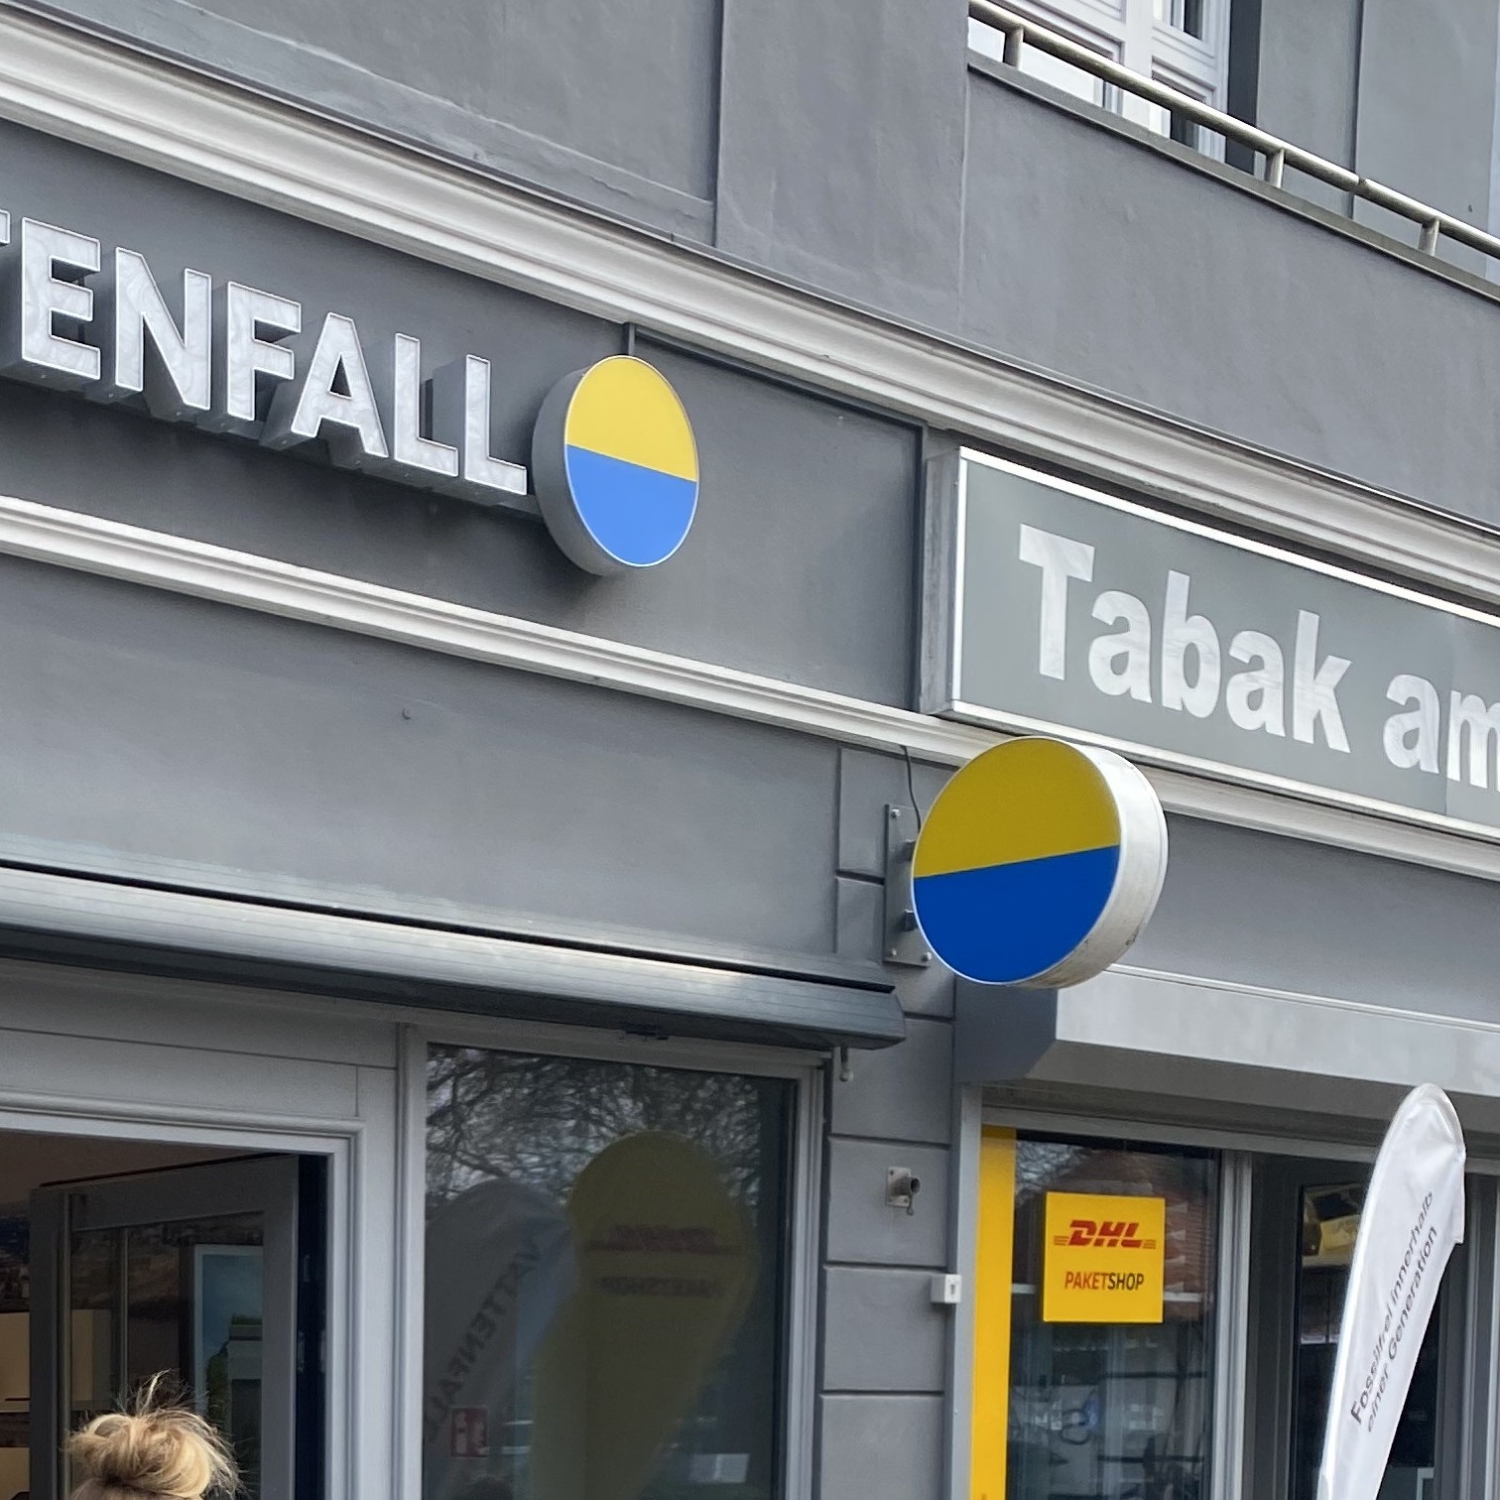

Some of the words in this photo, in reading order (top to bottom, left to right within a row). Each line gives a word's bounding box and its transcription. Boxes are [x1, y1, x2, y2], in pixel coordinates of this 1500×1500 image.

[1018, 522, 1353, 754] Tabak
[1382, 673, 1500, 792] am
[1064, 1270, 1145, 1292] PAKETSHOP
[1068, 1219, 1145, 1249] DHL
[1350, 1303, 1393, 1425] Fossilfrei
[1391, 1191, 1434, 1306] innerhalb
[1367, 1362, 1390, 1433] einer
[1388, 1225, 1438, 1361] Generation
